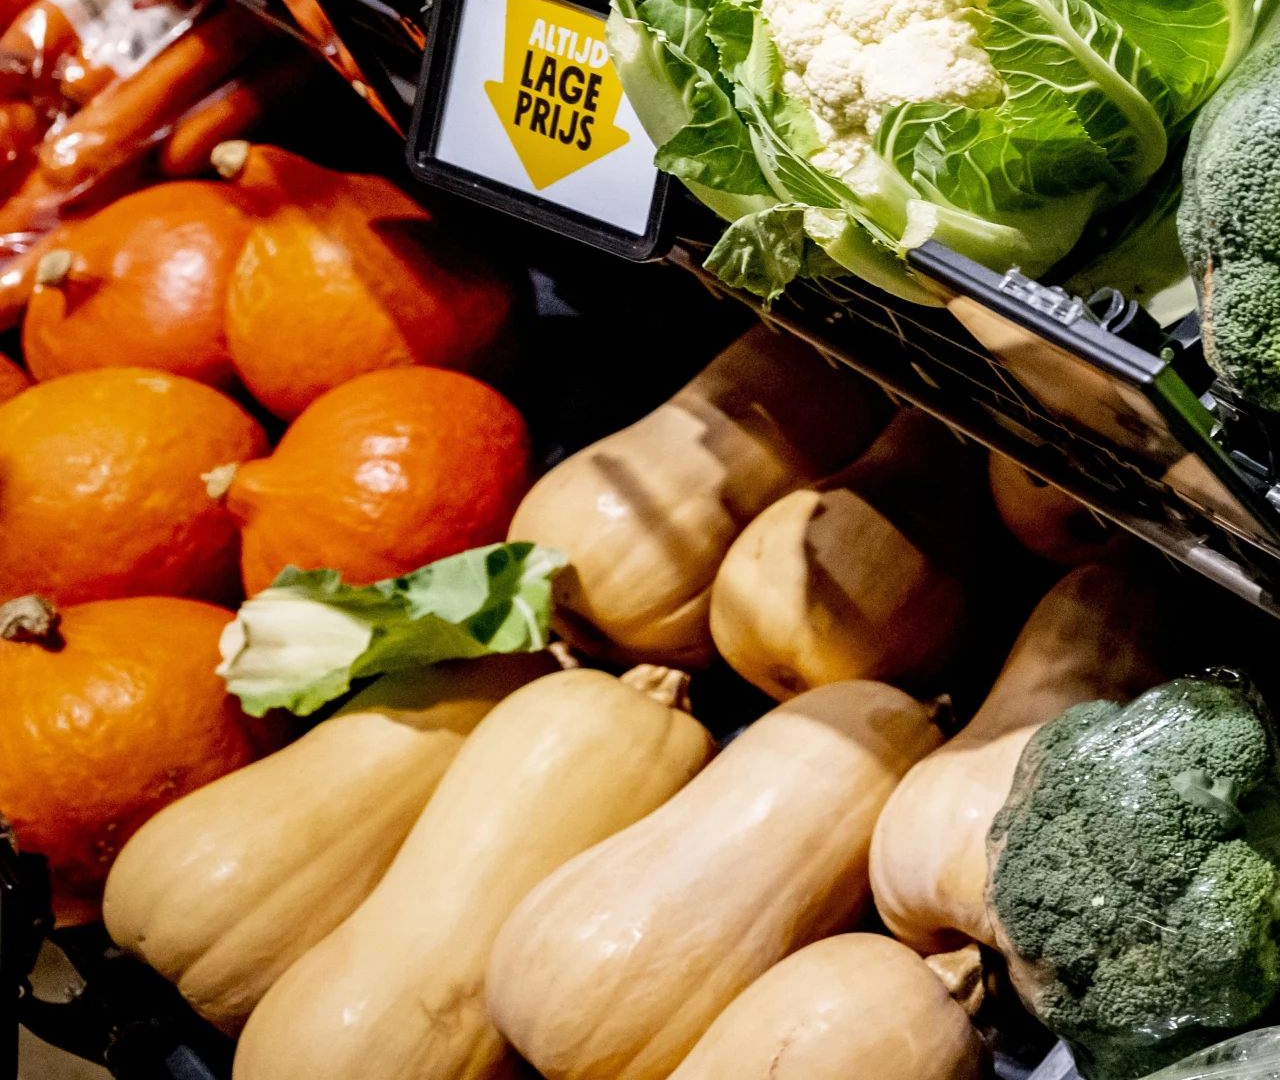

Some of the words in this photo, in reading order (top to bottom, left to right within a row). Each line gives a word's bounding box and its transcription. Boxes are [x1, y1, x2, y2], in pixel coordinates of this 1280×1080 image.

[528, 18, 609, 68] ALTIJD
[520, 49, 602, 112] LAGE
[513, 90, 594, 151] PRIJS
